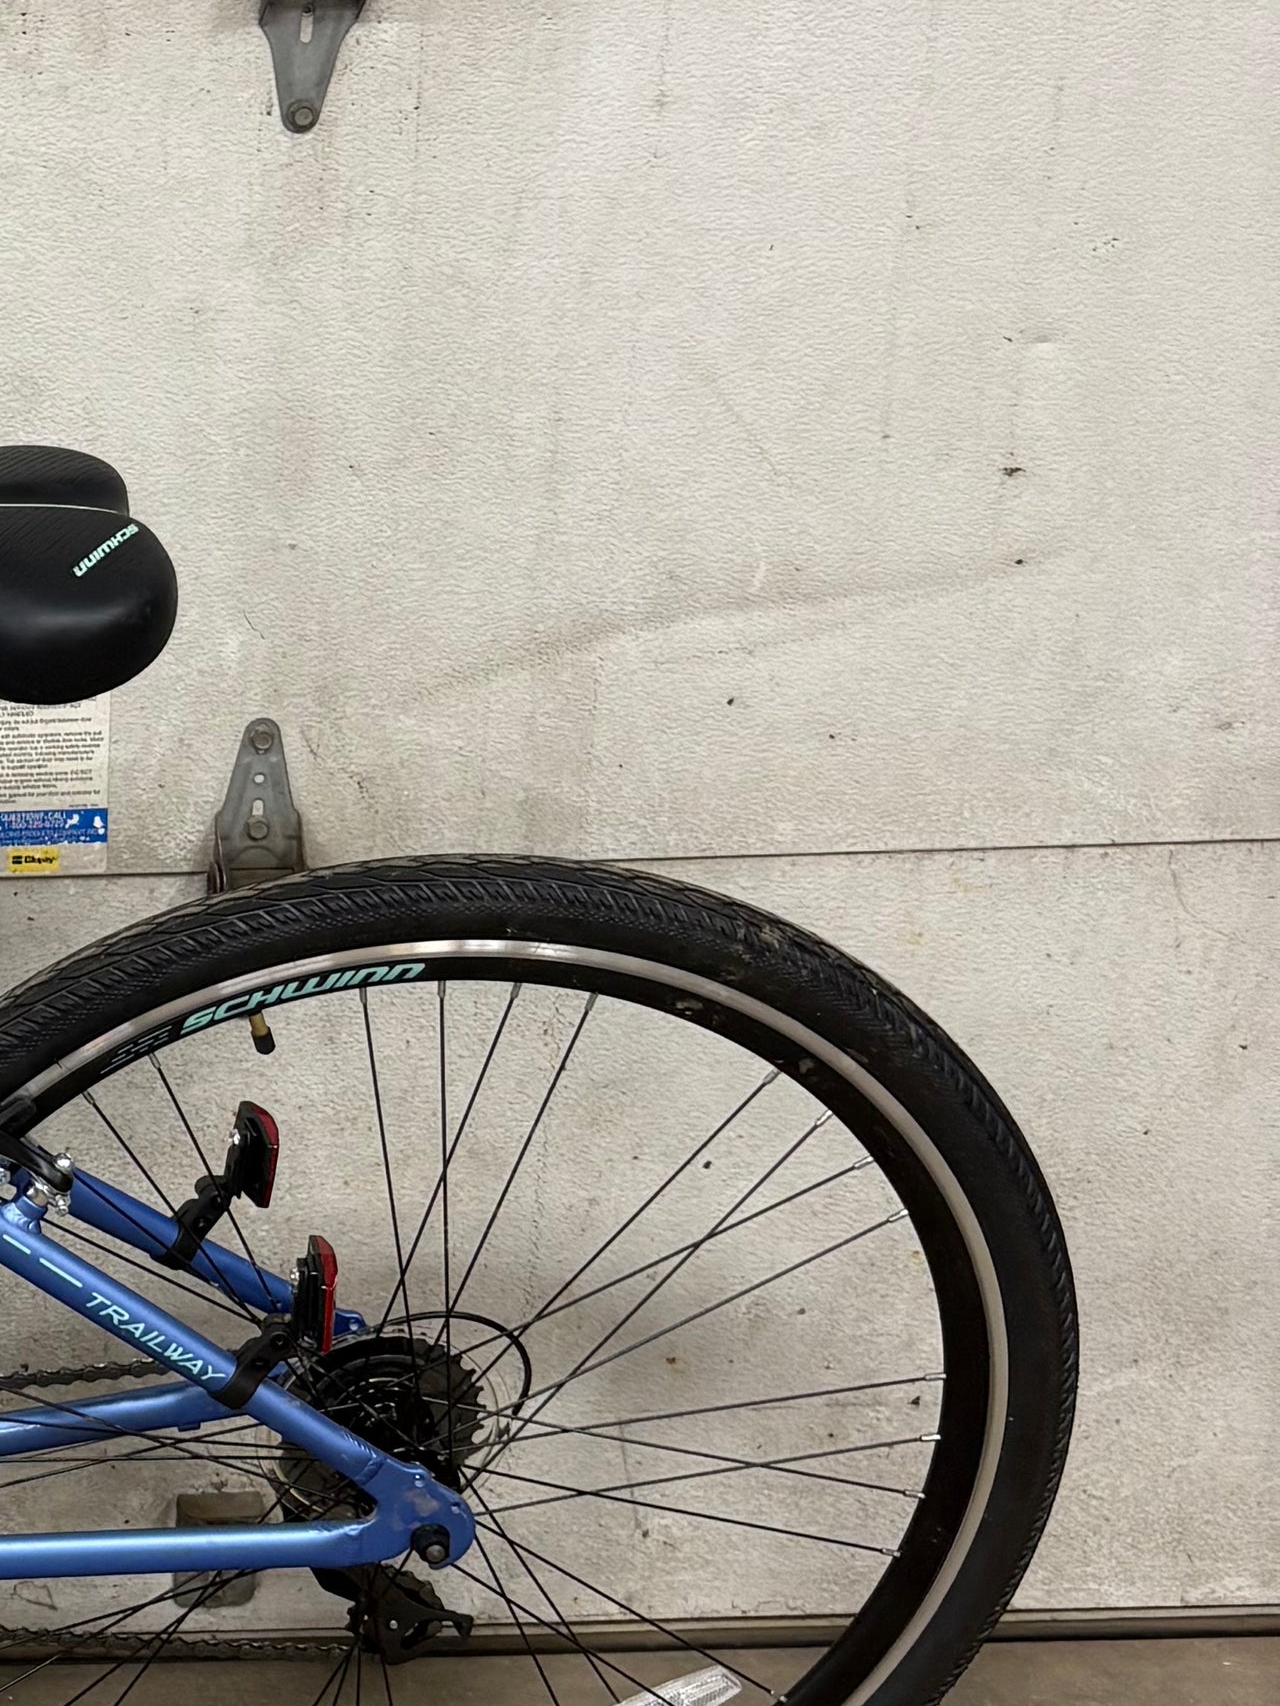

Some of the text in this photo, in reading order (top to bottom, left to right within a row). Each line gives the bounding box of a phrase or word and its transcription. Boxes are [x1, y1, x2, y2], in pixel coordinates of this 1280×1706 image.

[72, 523, 139, 577] SCHWINN
[180, 962, 426, 1035] SCHWINN
[86, 1292, 226, 1380] TRAILWAY
